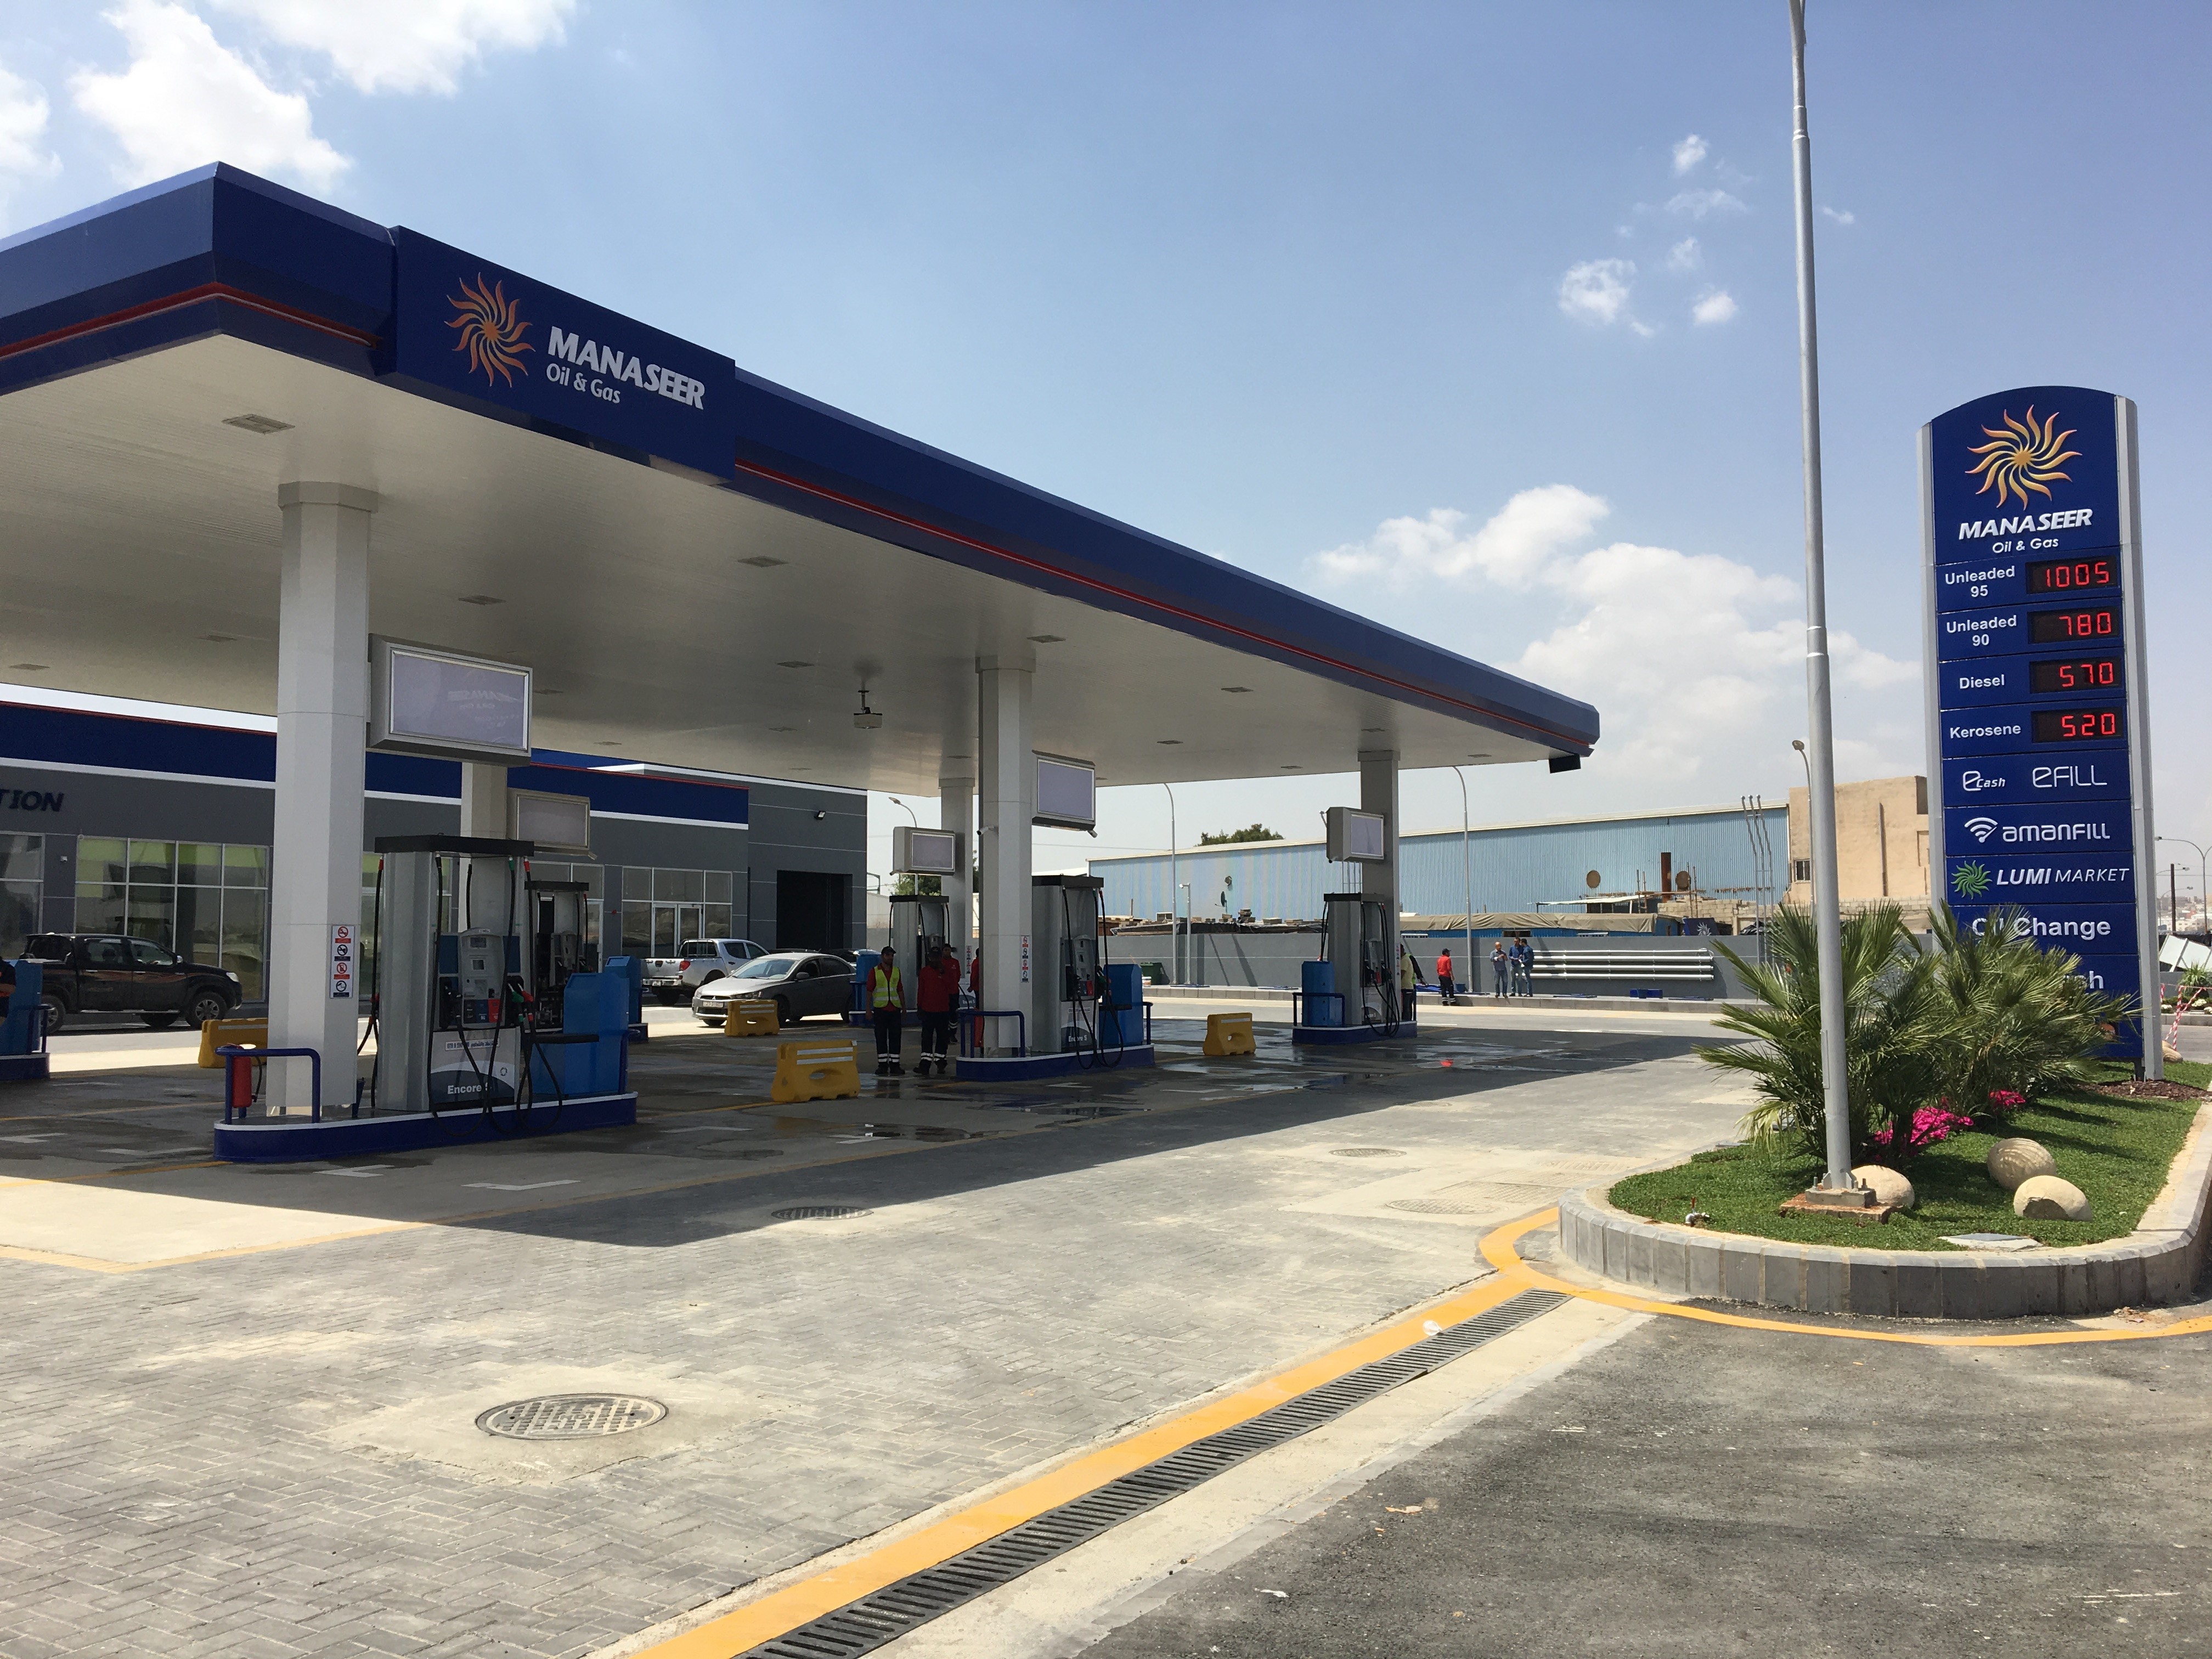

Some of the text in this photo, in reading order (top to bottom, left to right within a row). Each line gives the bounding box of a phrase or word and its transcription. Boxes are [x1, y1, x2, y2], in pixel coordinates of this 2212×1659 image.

[548, 326, 706, 410] MANASEER
[546, 363, 621, 404] Oil & Gas
[1959, 509, 2093, 540] MANASEER
[1992, 538, 2059, 554] Oil & Gas
[1945, 566, 2015, 585] Unleaded
[2046, 562, 2109, 588] 1005
[1970, 584, 1988, 597] 95
[1946, 614, 2017, 633] Unleaded
[2059, 612, 2111, 636] 780
[1972, 634, 1990, 646] 90
[1959, 674, 2005, 689] Diesel
[2059, 662, 2114, 687] 570
[1950, 725, 2021, 739] Kerosene
[2062, 713, 2115, 737] 520
[1996, 868, 2130, 885] LUMI MARKET
[2013, 917, 2111, 940] Change
[448, 1085, 482, 1094] Encore
